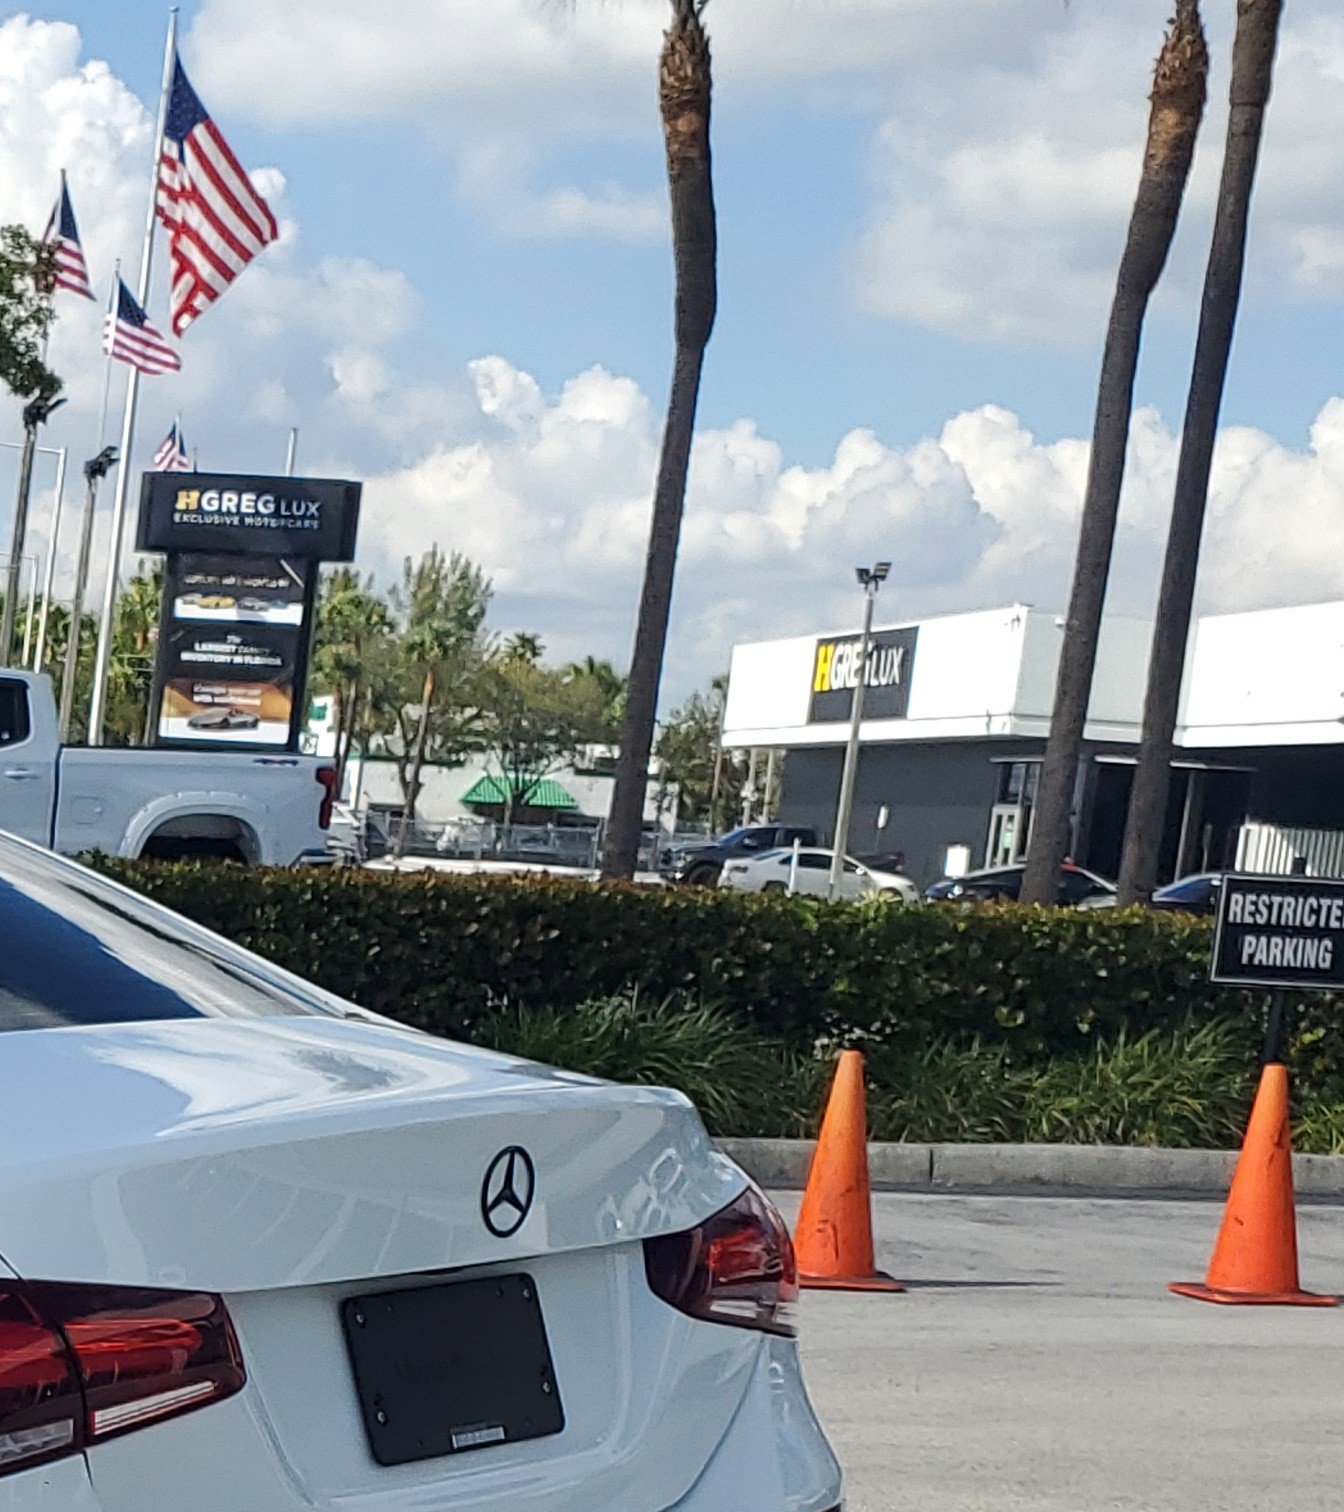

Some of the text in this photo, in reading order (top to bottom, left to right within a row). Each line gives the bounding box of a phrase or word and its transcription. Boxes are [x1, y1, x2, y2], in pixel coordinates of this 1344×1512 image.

[175, 489, 321, 516] HGREG LUX
[1228, 893, 1344, 929] RESTRICTE
[1241, 934, 1333, 969] PARKING
